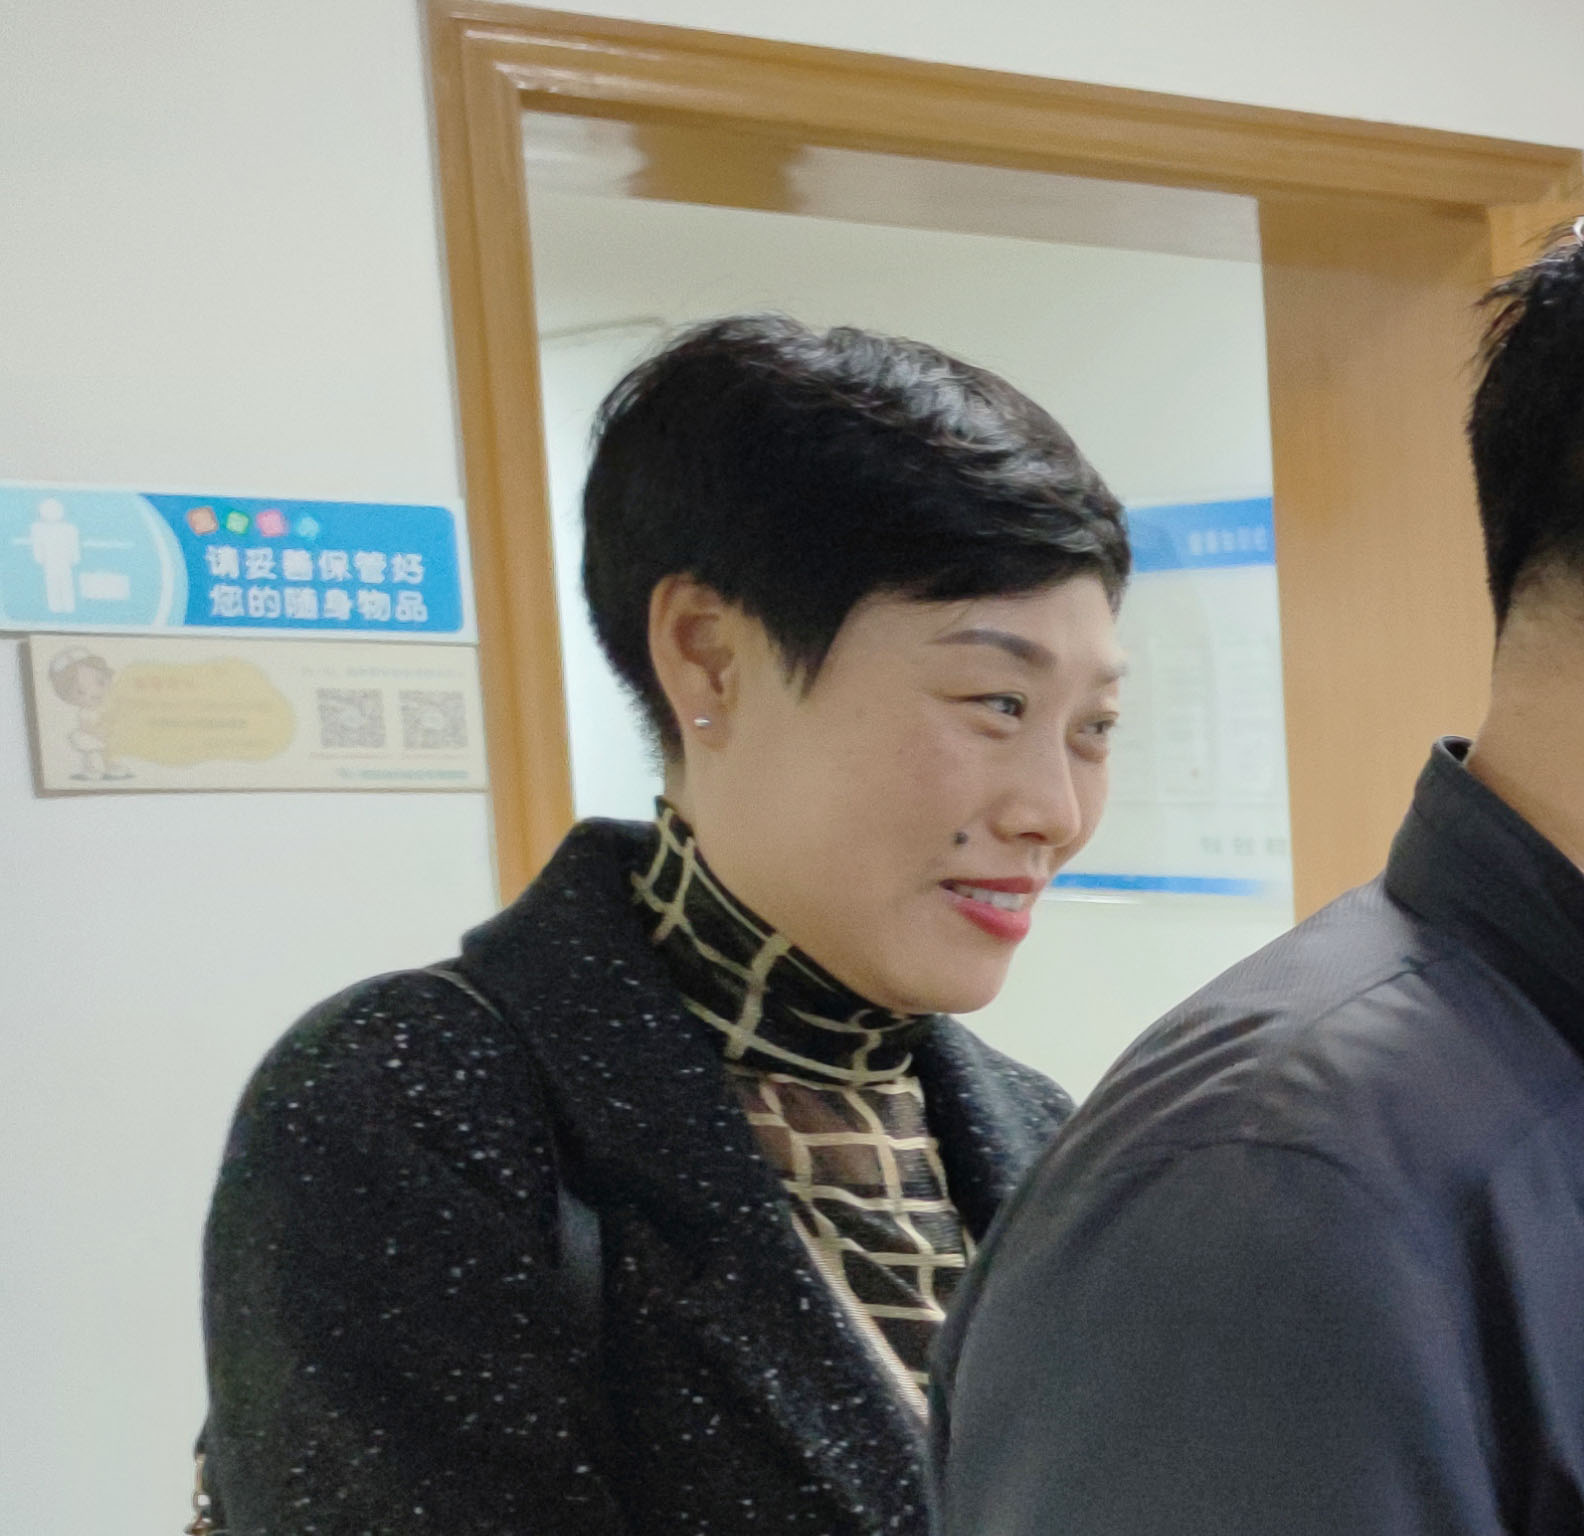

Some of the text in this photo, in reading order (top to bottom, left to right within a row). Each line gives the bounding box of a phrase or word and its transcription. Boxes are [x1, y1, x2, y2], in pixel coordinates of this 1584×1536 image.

[207, 545, 424, 584] 请妥善保管好
[211, 584, 429, 621] 您的随身物品
